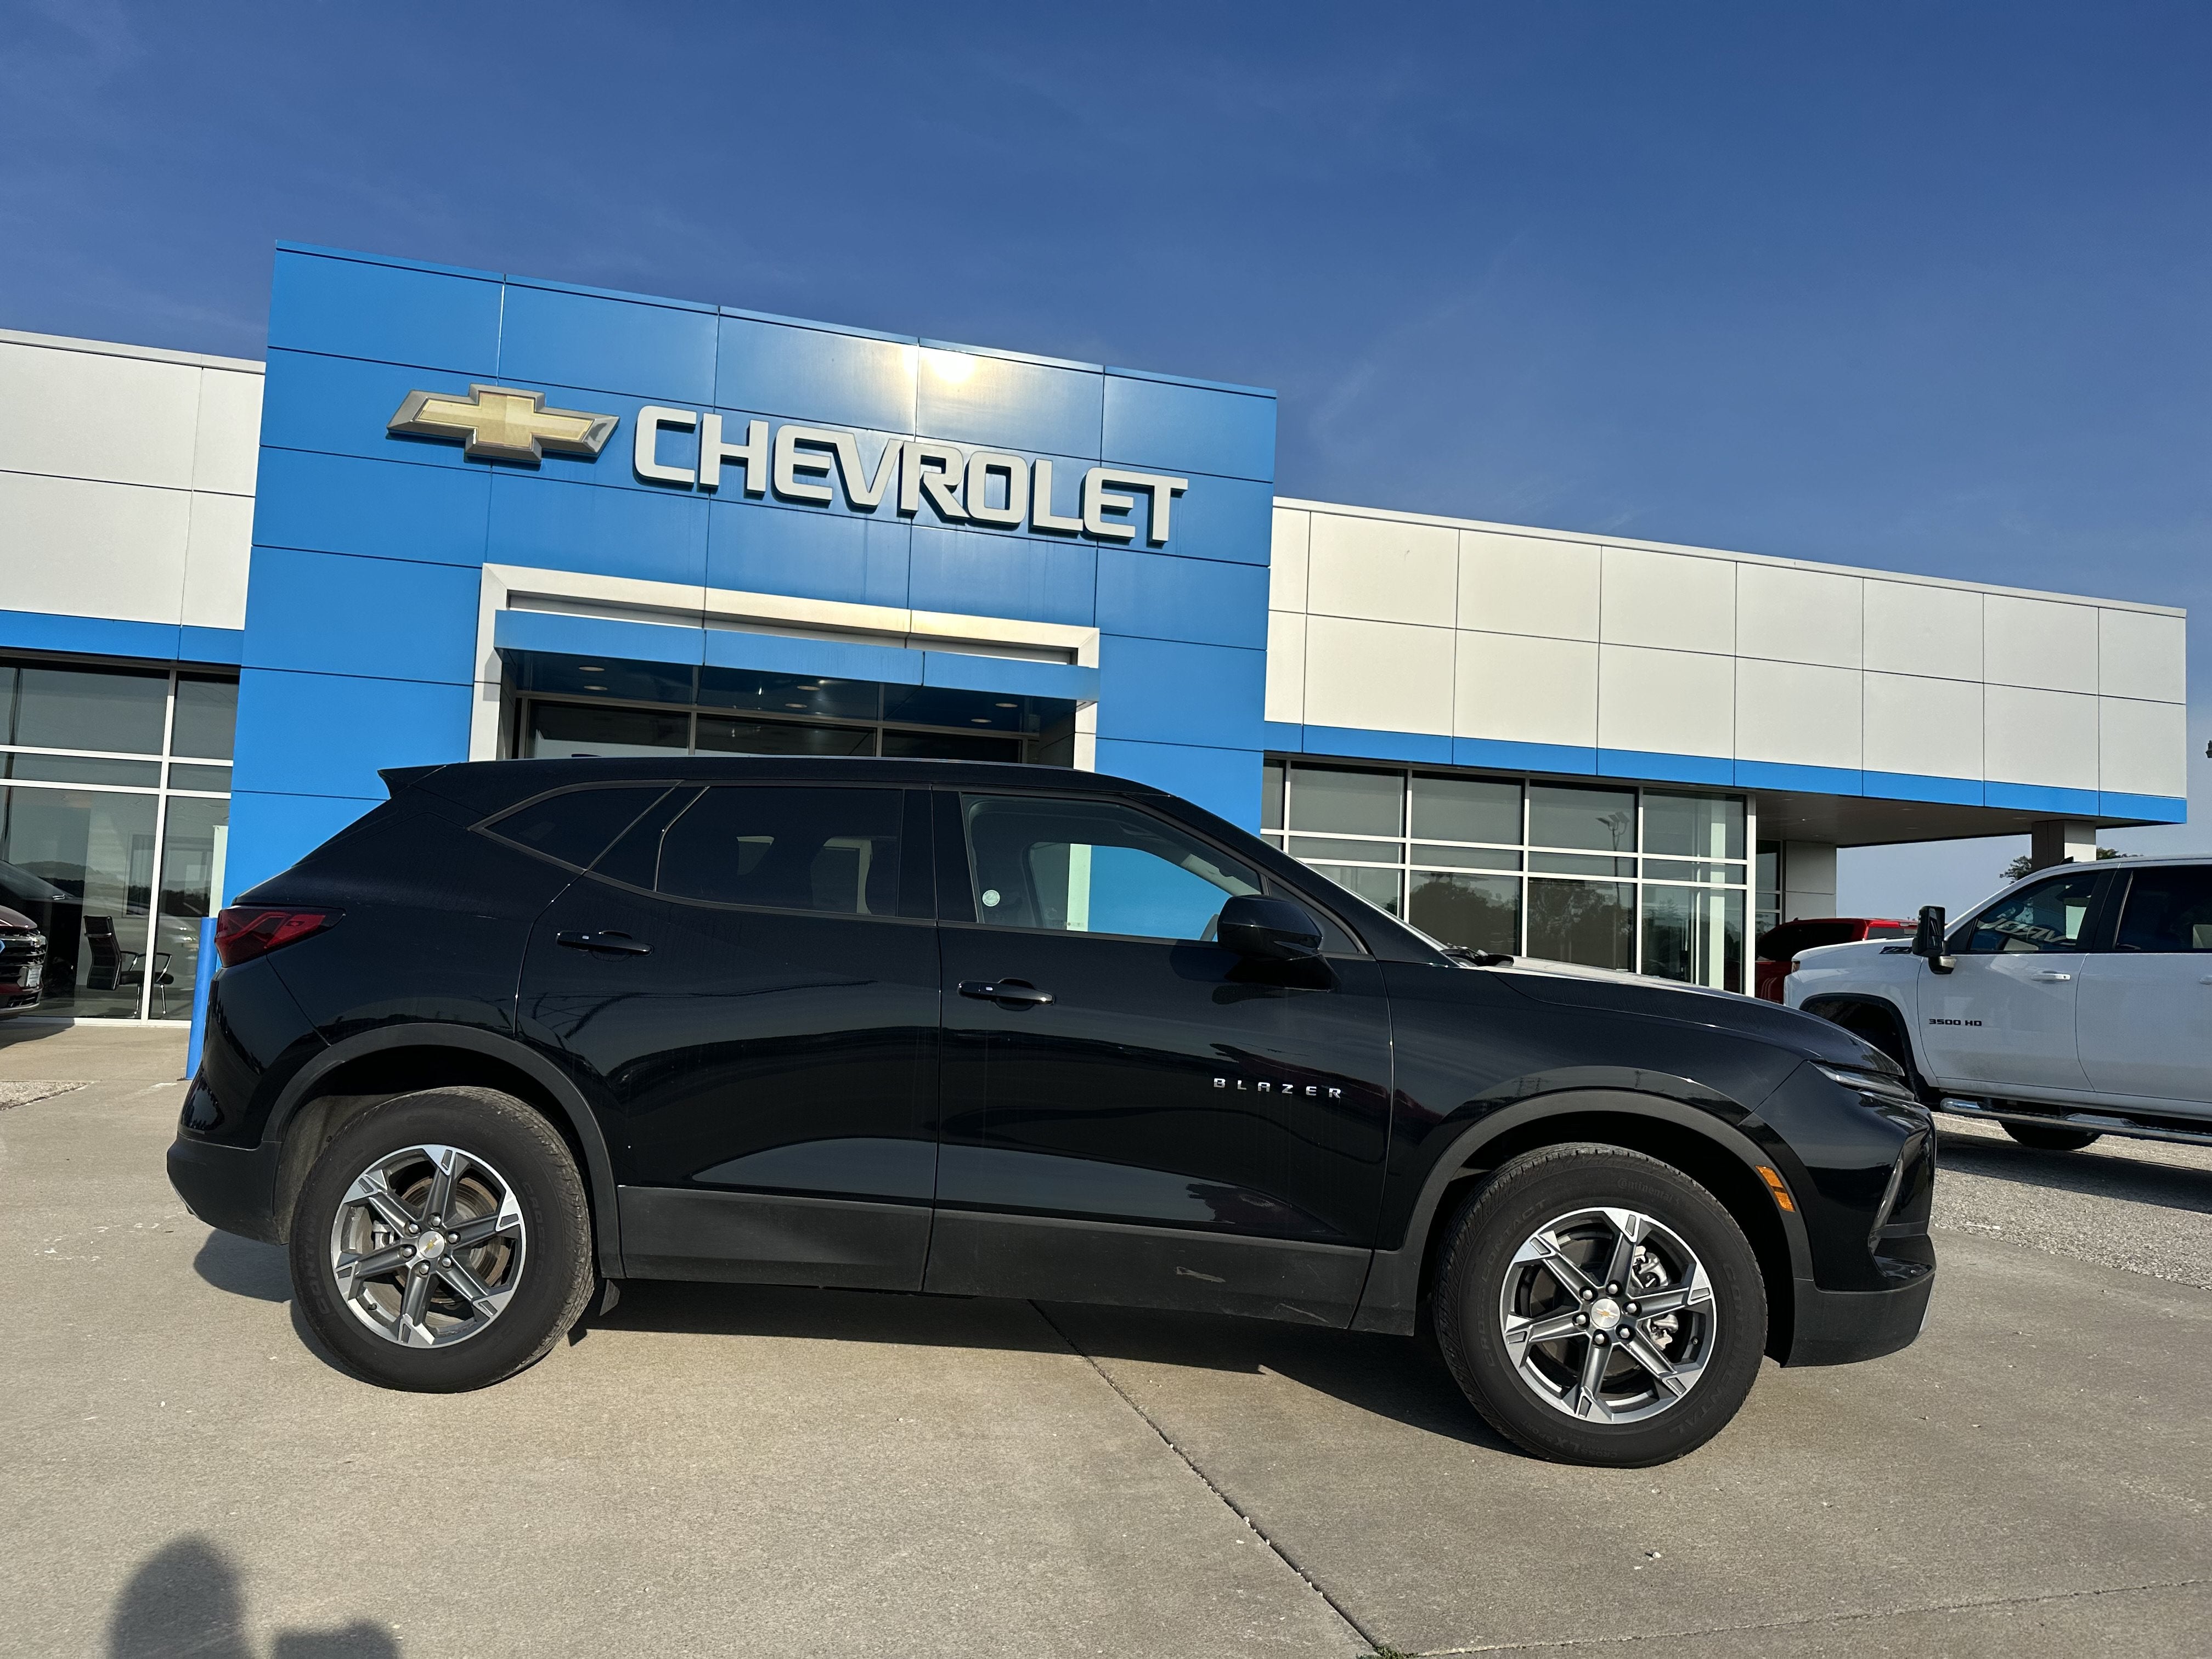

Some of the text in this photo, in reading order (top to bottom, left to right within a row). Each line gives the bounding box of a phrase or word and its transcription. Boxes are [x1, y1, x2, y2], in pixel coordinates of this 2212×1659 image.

[634, 405, 1188, 544] CHEVROLET
[1214, 1078, 1341, 1098] BLAZER
[1618, 1178, 1672, 1203] Continental
